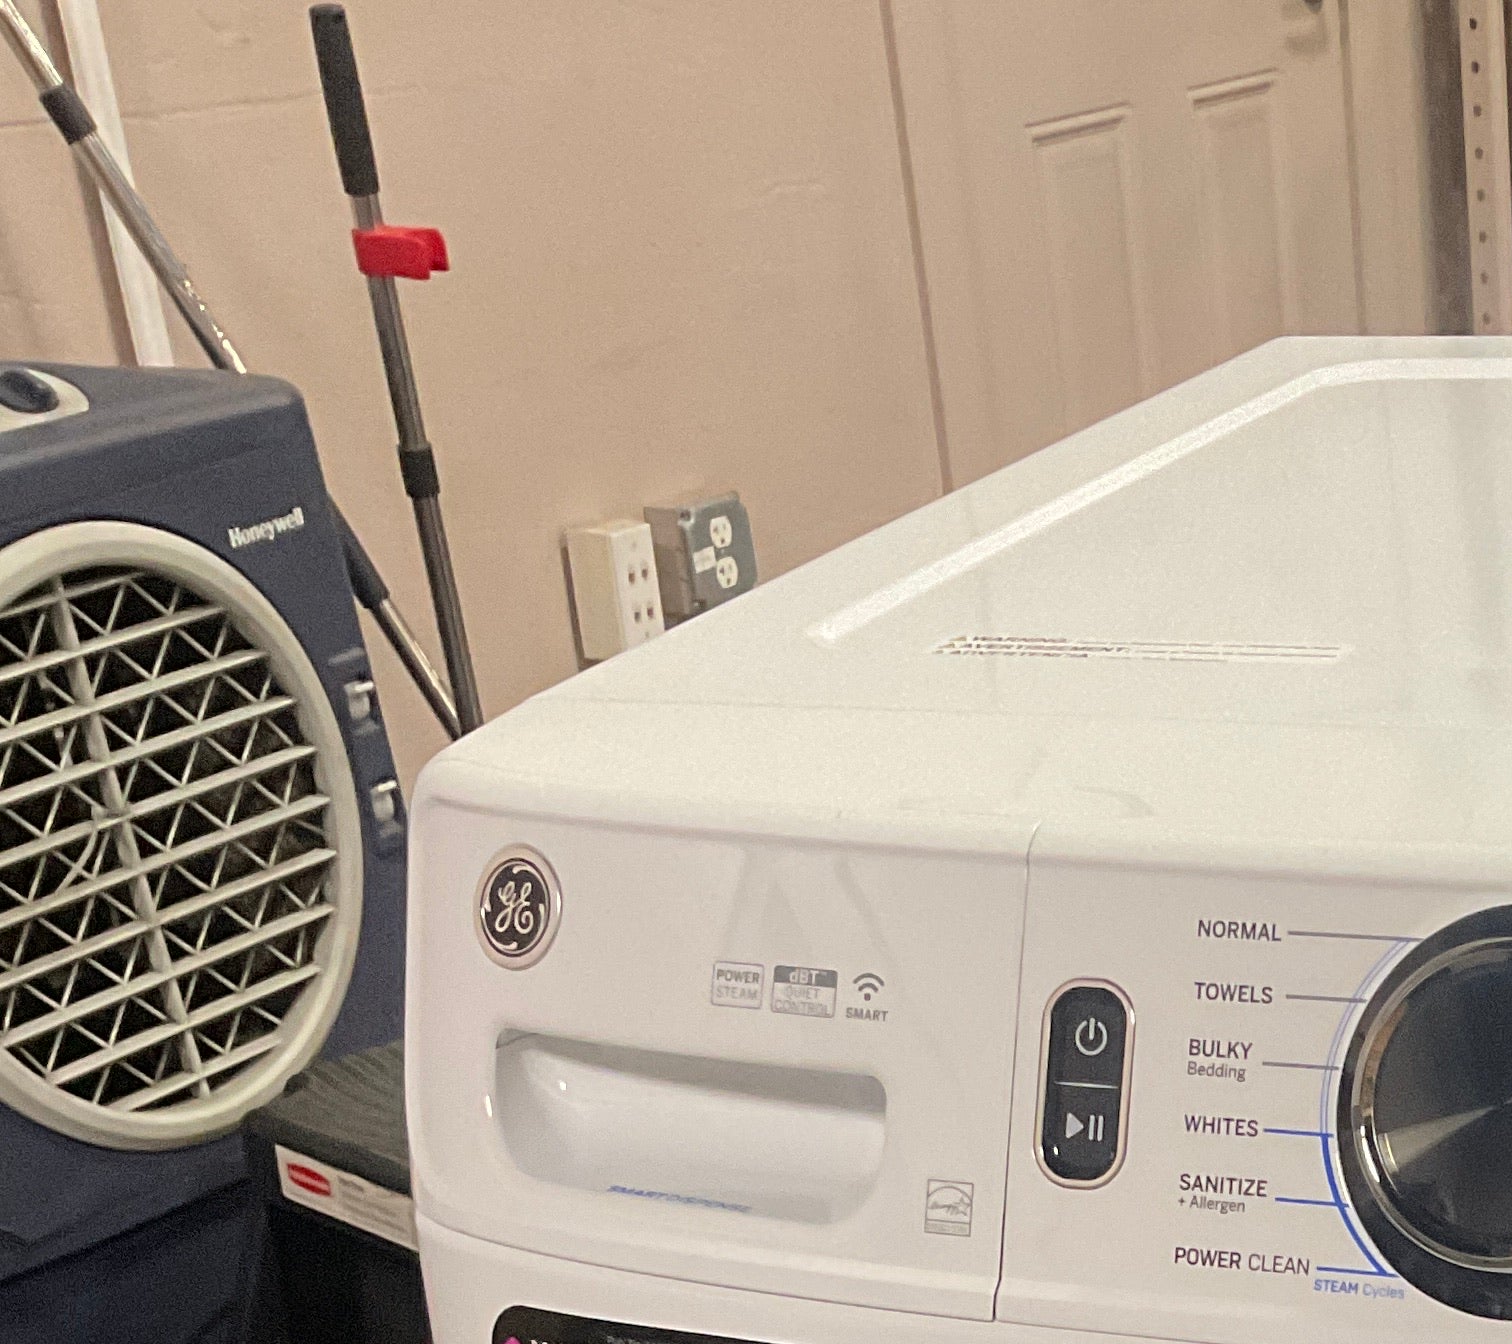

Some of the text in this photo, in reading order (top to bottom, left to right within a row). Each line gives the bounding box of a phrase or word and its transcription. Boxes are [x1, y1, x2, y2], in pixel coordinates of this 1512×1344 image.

[227, 507, 305, 549] Honeywell
[1197, 919, 1282, 942] NORMAL
[716, 968, 760, 985] POWER
[1194, 981, 1273, 1004] TOWELS
[845, 1006, 889, 1023] SMART
[1188, 1038, 1253, 1060] BULKY
[1187, 1060, 1246, 1083] Bedding
[1184, 1114, 1259, 1137] WHITES
[1179, 1173, 1268, 1198] SANITIZE
[1189, 1195, 1246, 1215] Allergen
[1174, 1246, 1310, 1276] POWER CLEAN
[1313, 1278, 1405, 1300] STEAM Cycles
